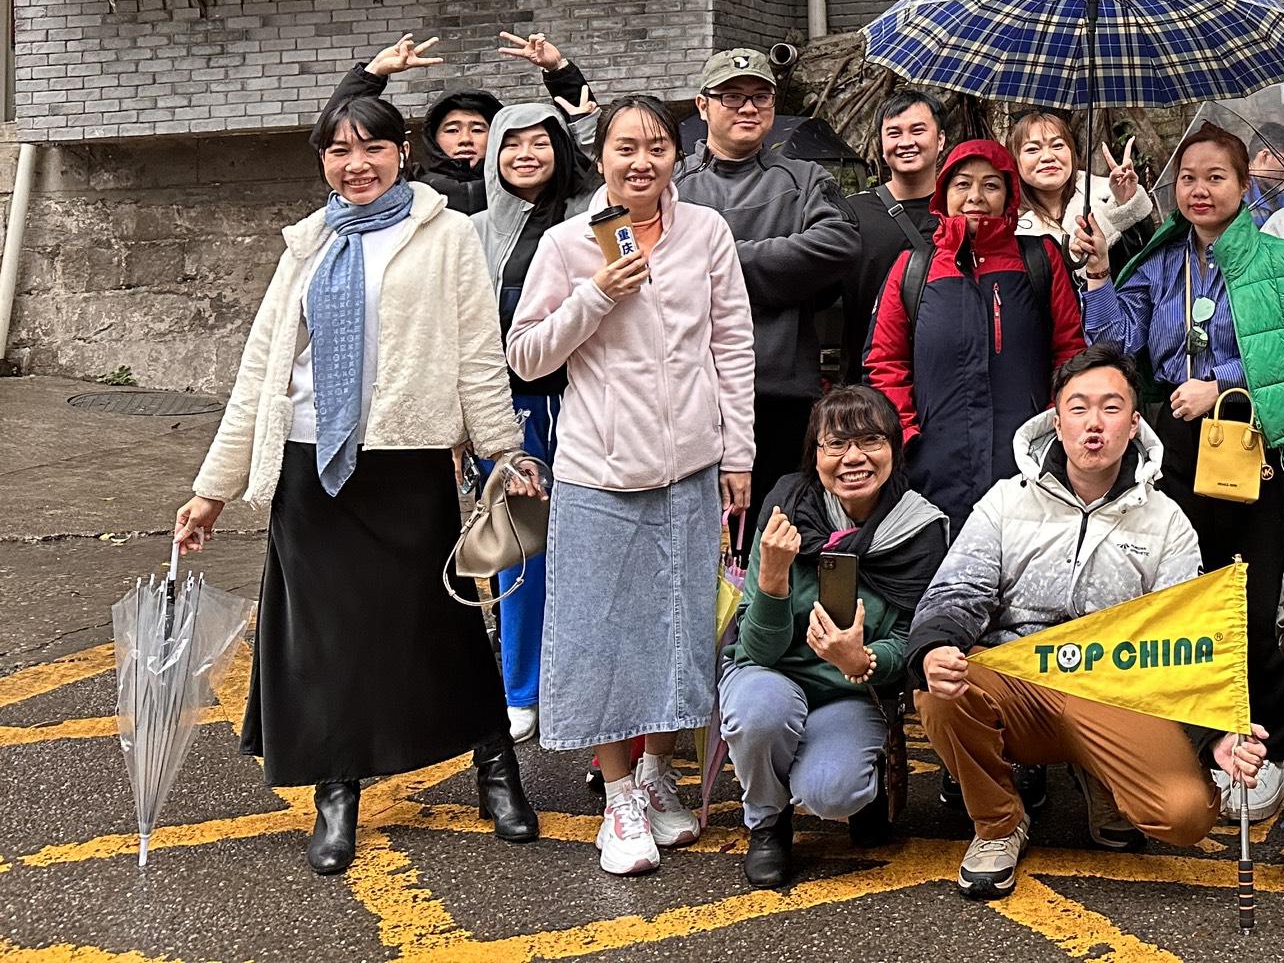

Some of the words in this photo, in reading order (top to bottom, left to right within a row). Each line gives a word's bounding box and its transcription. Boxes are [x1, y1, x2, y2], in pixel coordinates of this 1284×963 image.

[617, 229, 635, 255] 重庆
[1034, 642, 1105, 674] TOP
[1112, 637, 1214, 671] CHINA
